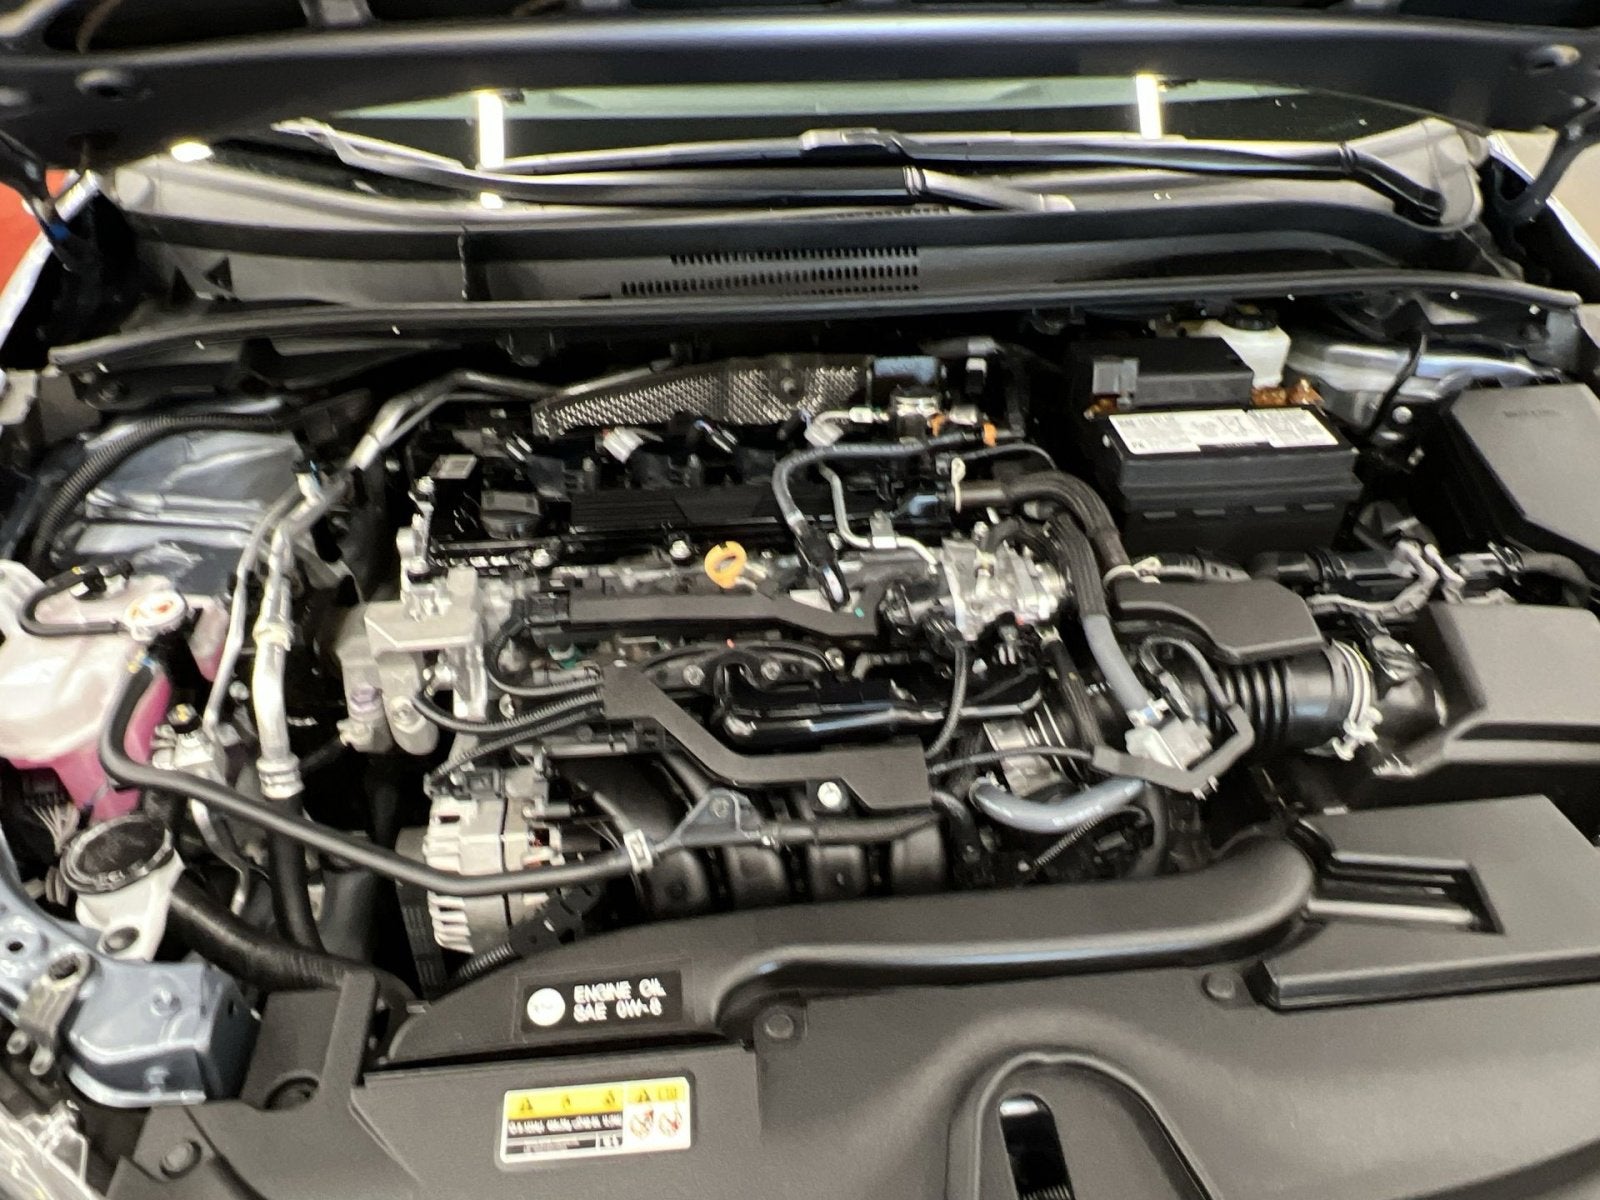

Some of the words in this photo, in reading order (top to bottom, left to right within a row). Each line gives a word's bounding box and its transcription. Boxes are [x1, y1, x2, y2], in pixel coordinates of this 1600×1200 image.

[574, 981, 631, 1002] ENGINE
[639, 978, 666, 997] OIL
[573, 1002, 607, 1022] SAE
